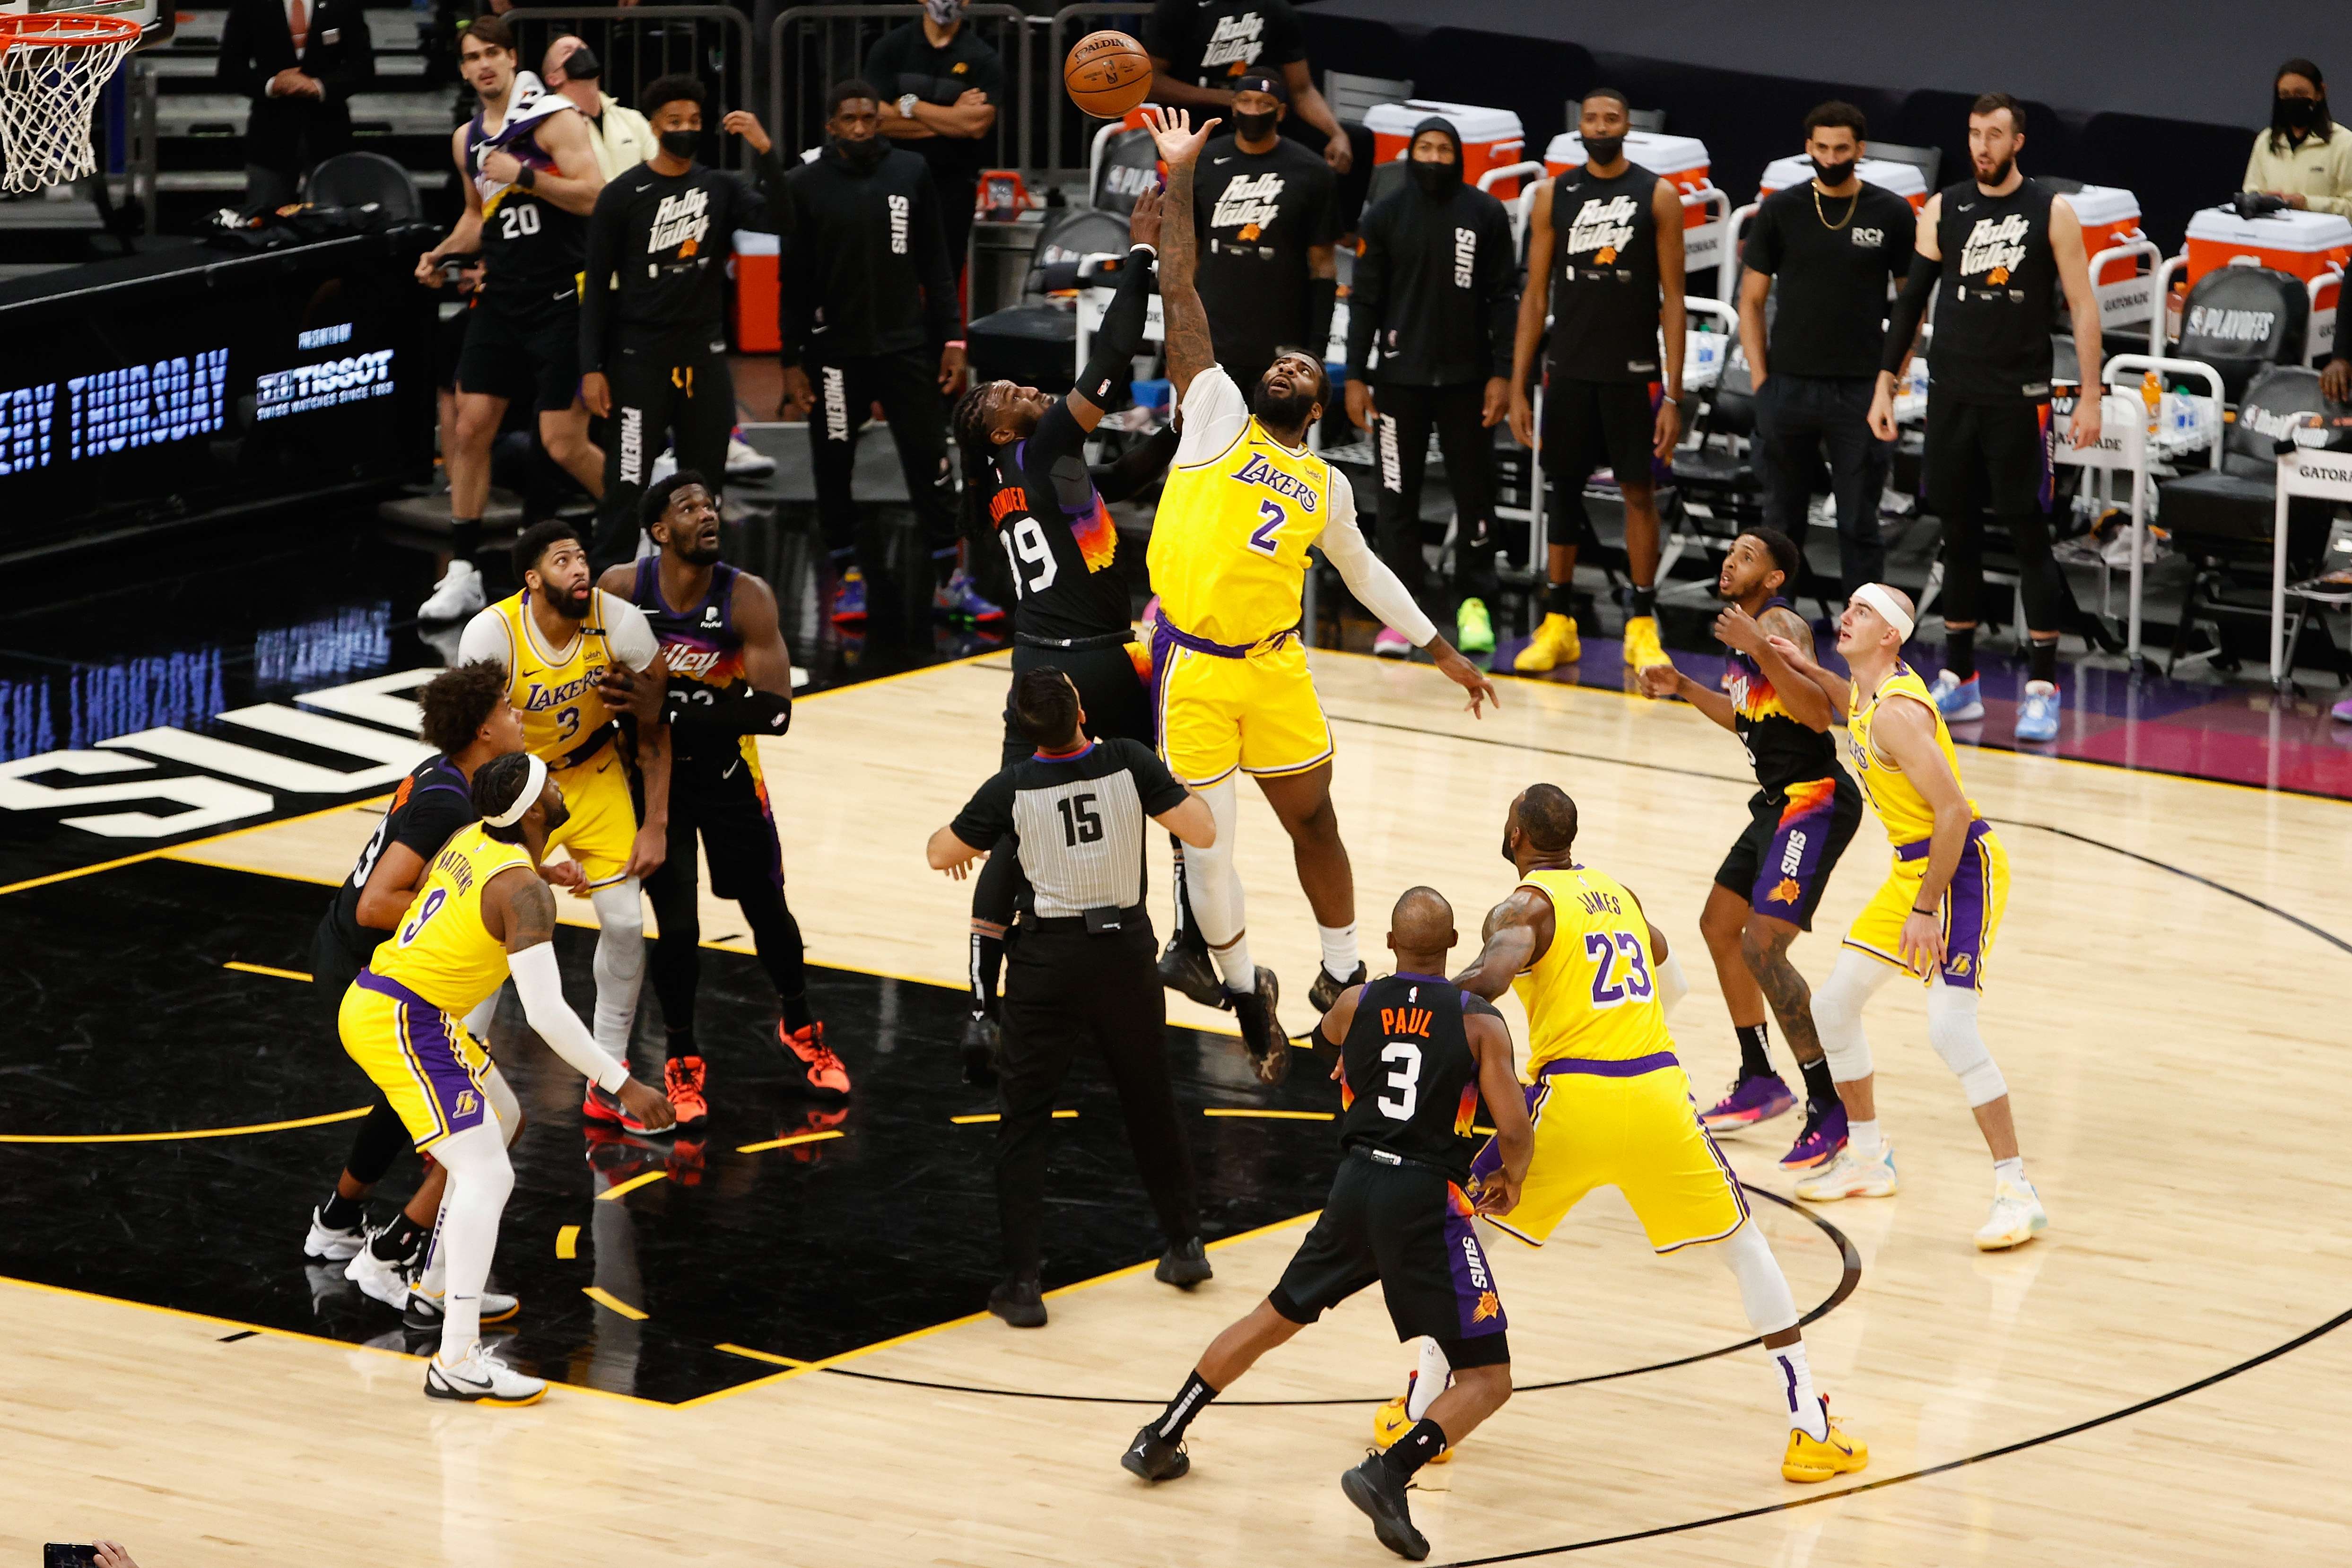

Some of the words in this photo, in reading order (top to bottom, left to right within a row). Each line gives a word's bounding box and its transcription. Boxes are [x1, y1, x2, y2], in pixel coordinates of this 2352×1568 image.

[1210, 12, 1264, 42] Rally
[1201, 37, 1264, 67] Valley
[653, 187, 709, 226] Rally
[1219, 173, 1286, 204] Rally
[1572, 195, 1638, 227] Rally
[499, 203, 541, 239] 20
[647, 214, 710, 254] Valley
[888, 194, 909, 254] SUNS
[1211, 199, 1280, 230] Valley
[1567, 221, 1635, 255] Valley
[1965, 214, 2030, 249] Rally
[1455, 227, 1476, 289] SUNS
[1960, 241, 2027, 276] Valley
[293, 349, 394, 397] TISSOT
[68, 348, 229, 461] THURSDAY
[822, 366, 849, 442] PHOENIX
[620, 406, 643, 486] PHOENIX
[1379, 412, 1402, 494] PHOENIX
[1230, 453, 1317, 512] LAKERS
[1249, 498, 1286, 553] 2
[557, 706, 580, 743] 3
[1057, 794, 1103, 847] 15
[436, 851, 473, 897] MATTHEWS
[1781, 829, 1806, 877] SUNS
[402, 887, 448, 945] 9
[1577, 891, 1621, 915] JAMES
[1584, 932, 1653, 1005] 23
[1380, 1008, 1433, 1038] PAUL
[1378, 1042, 1422, 1122] 3
[1462, 1236, 1488, 1289] SUNS
